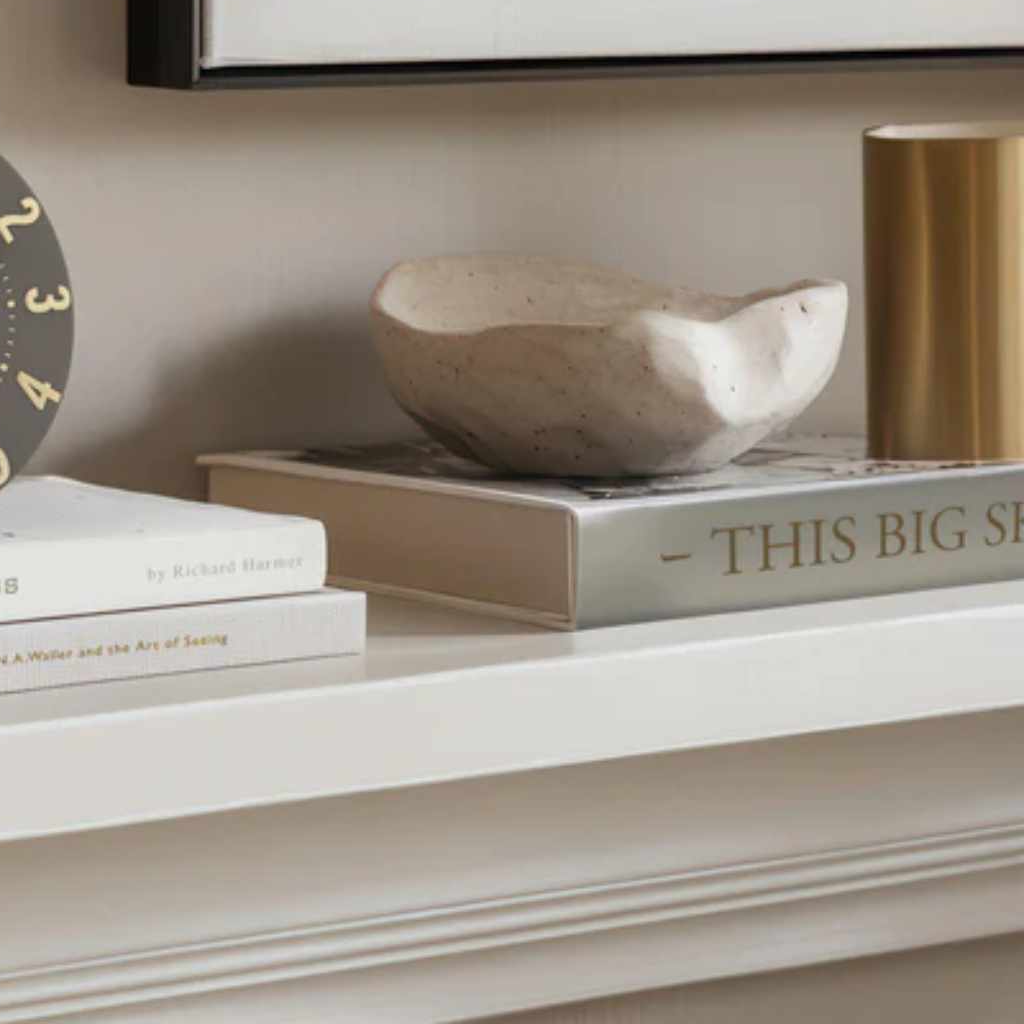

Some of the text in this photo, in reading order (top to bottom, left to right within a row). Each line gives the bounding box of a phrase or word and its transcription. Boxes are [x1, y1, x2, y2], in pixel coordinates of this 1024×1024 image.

[25, 285, 71, 314] 3
[16, 371, 63, 411] 4
[710, 516, 857, 576] THIS
[876, 506, 968, 560] BIG
[147, 568, 165, 584] by
[173, 560, 237, 579] Richard
[79, 644, 103, 658] and
[107, 642, 130, 655] the
[136, 639, 161, 652] Art
[164, 635, 180, 648] of
[183, 633, 228, 648] Seeing
